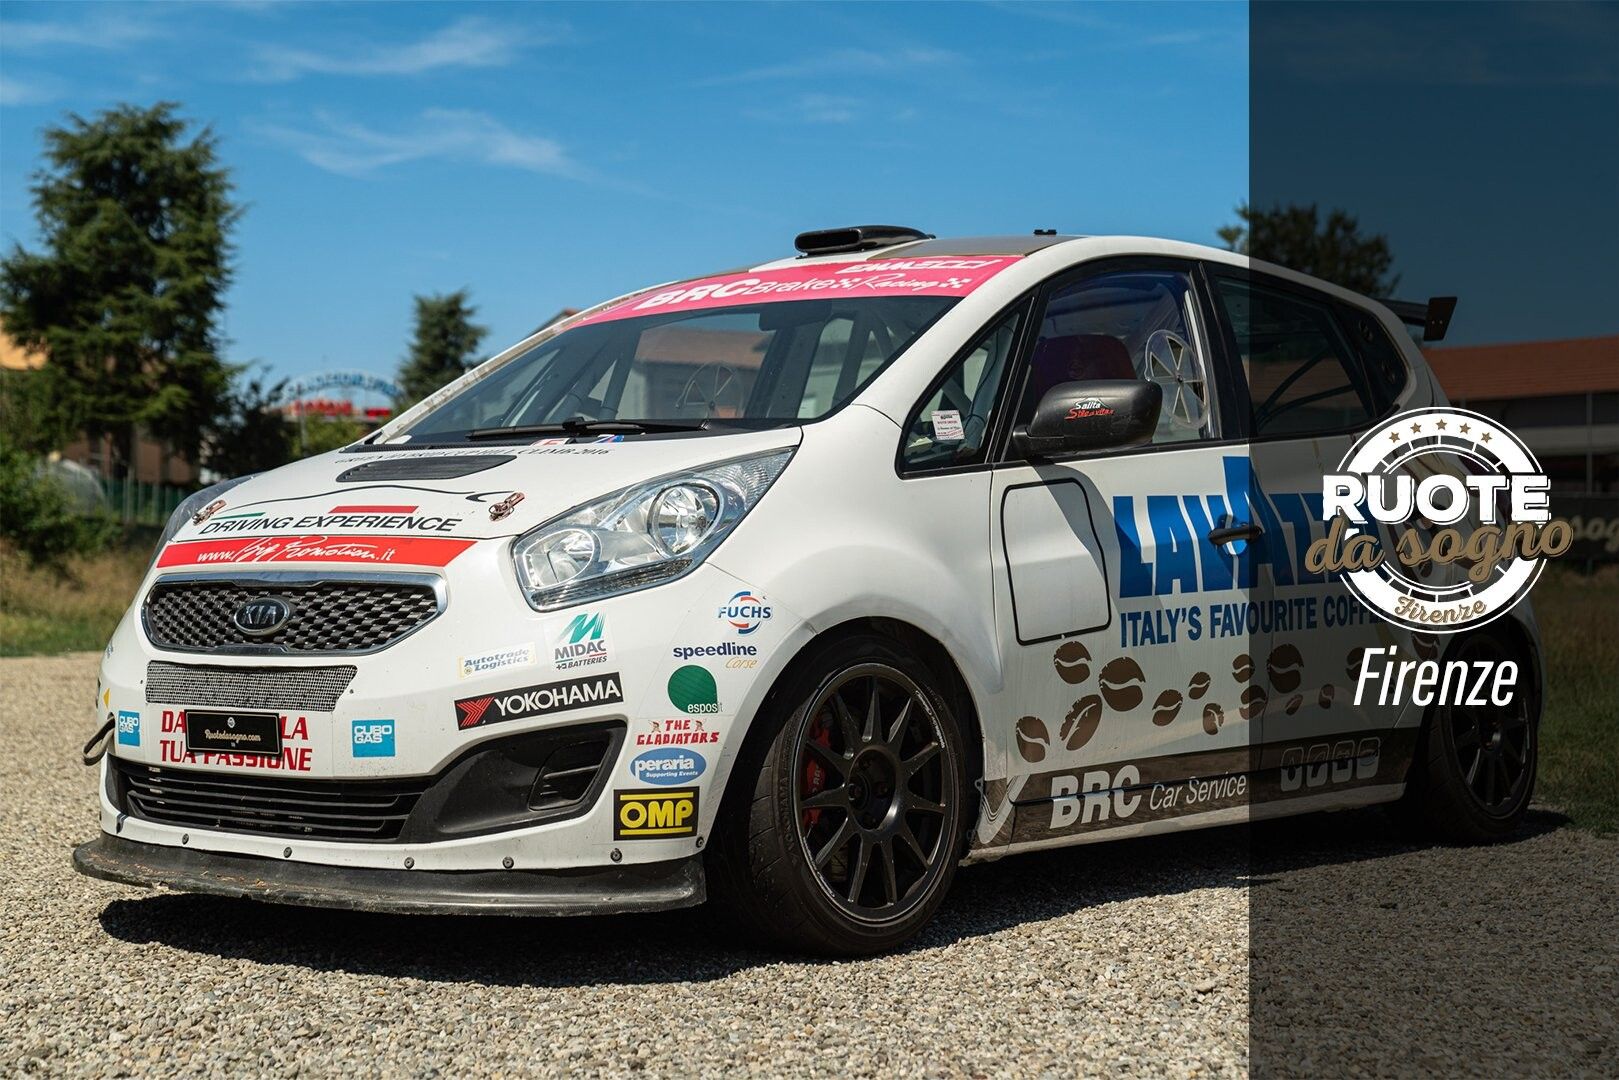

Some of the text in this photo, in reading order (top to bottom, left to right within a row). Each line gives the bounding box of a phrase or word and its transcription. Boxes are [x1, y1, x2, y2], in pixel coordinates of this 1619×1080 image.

[632, 278, 761, 311] BRC
[198, 515, 464, 535] DRIVING EXPERIENCE
[241, 605, 278, 625] KIA
[718, 606, 772, 619] FUCHS
[1120, 594, 1390, 648] ITALY'S FAVOURITE COFFE
[463, 647, 530, 668] Autotrade
[553, 639, 607, 661] MIDAC
[673, 642, 757, 660] speedline
[474, 655, 529, 672] Logistics
[567, 656, 608, 669] BATTERIES
[725, 656, 758, 669] Corse
[494, 679, 622, 717] YOKOHAMA
[119, 715, 139, 727] CUBO
[354, 724, 392, 735] CUBO
[665, 719, 691, 732] THE
[354, 733, 383, 744] GAS
[636, 731, 720, 746] GLADIATORS
[1050, 765, 1248, 829] BRC Car Service
[619, 799, 694, 829] OMP
